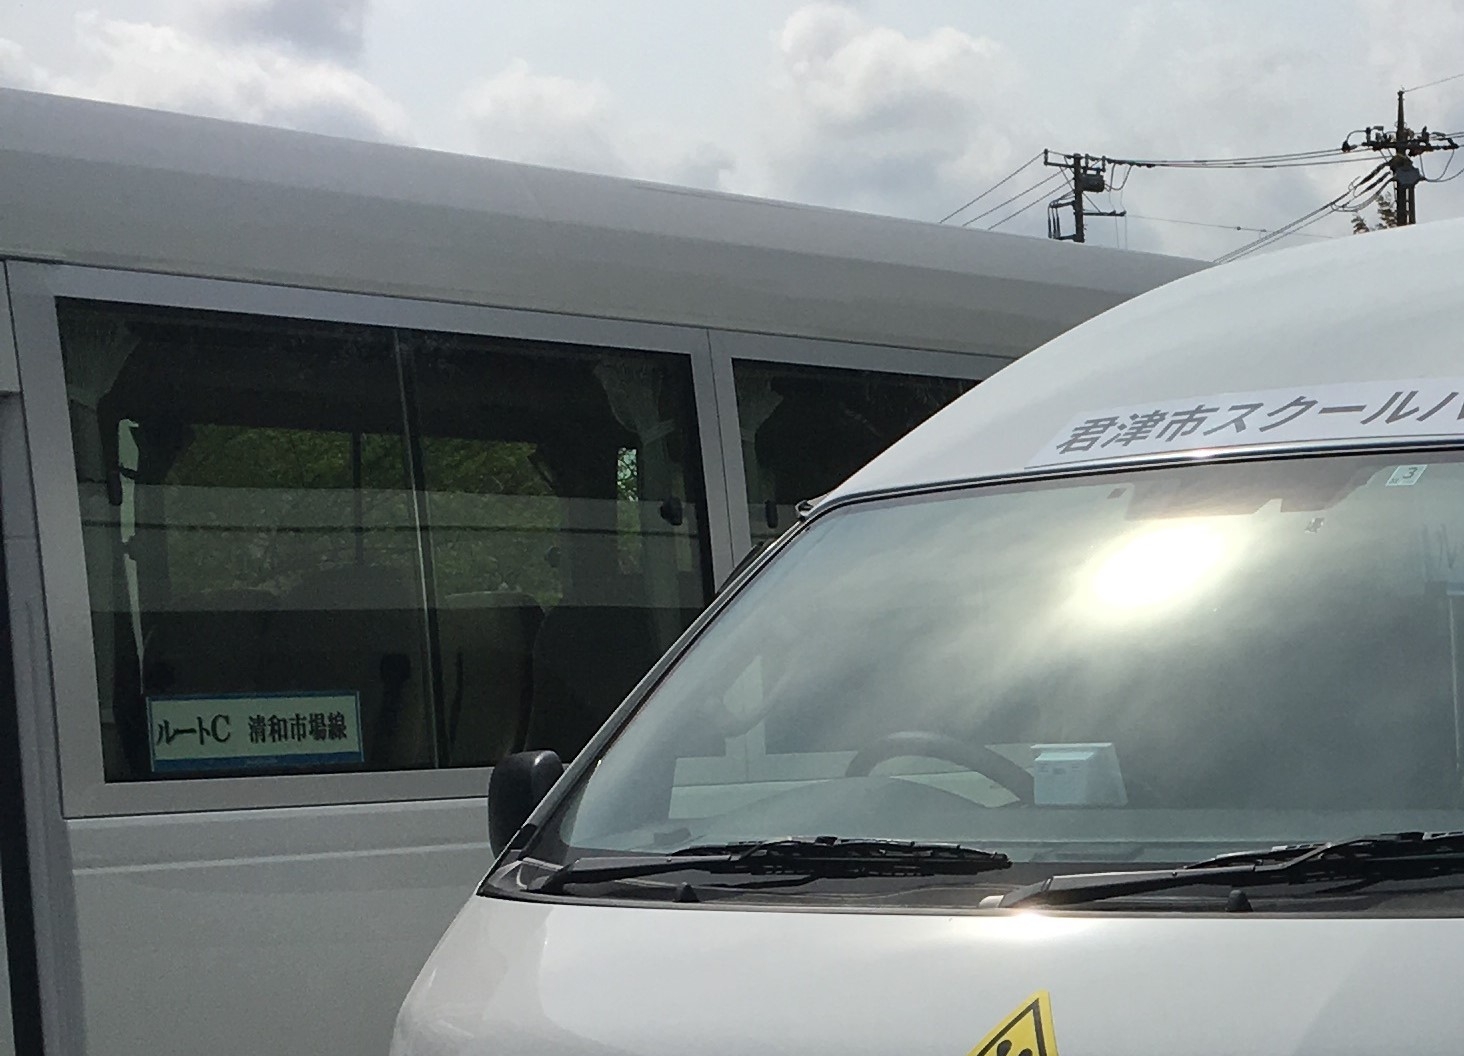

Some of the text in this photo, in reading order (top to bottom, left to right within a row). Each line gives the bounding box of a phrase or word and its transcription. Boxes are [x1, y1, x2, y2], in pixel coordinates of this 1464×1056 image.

[156, 711, 347, 745] ルートC 清和市場線
